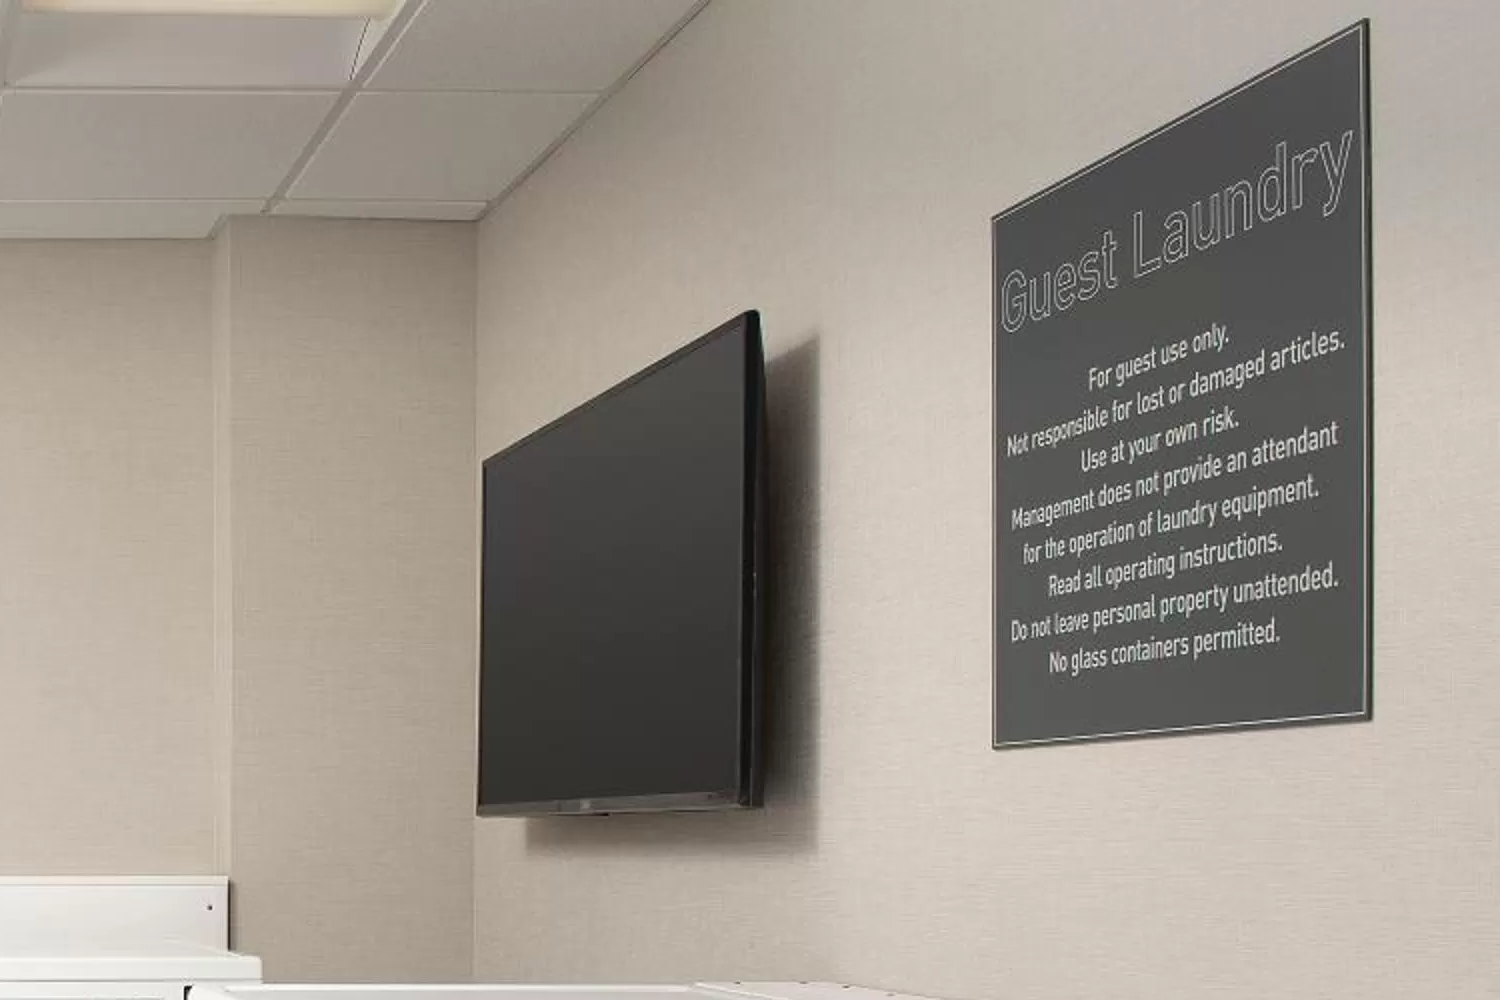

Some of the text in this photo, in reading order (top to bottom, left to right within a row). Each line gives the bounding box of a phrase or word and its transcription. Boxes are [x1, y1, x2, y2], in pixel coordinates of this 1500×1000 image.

[1001, 130, 1353, 333] Guest Laundry
[1007, 330, 1345, 457] Not responsible for lost or damaged articles.
[1089, 322, 1229, 391] For guest use only.
[1011, 420, 1339, 531] Management does not provide an attendant
[1081, 405, 1239, 472] Use at your own risk.
[1023, 472, 1319, 565] for the operation of laundry equipment.
[1011, 560, 1339, 643] Do not leave personal property unattended.
[1049, 532, 1282, 598] Read all operating instructions.
[1049, 615, 1281, 677] No glass containers permitted.
